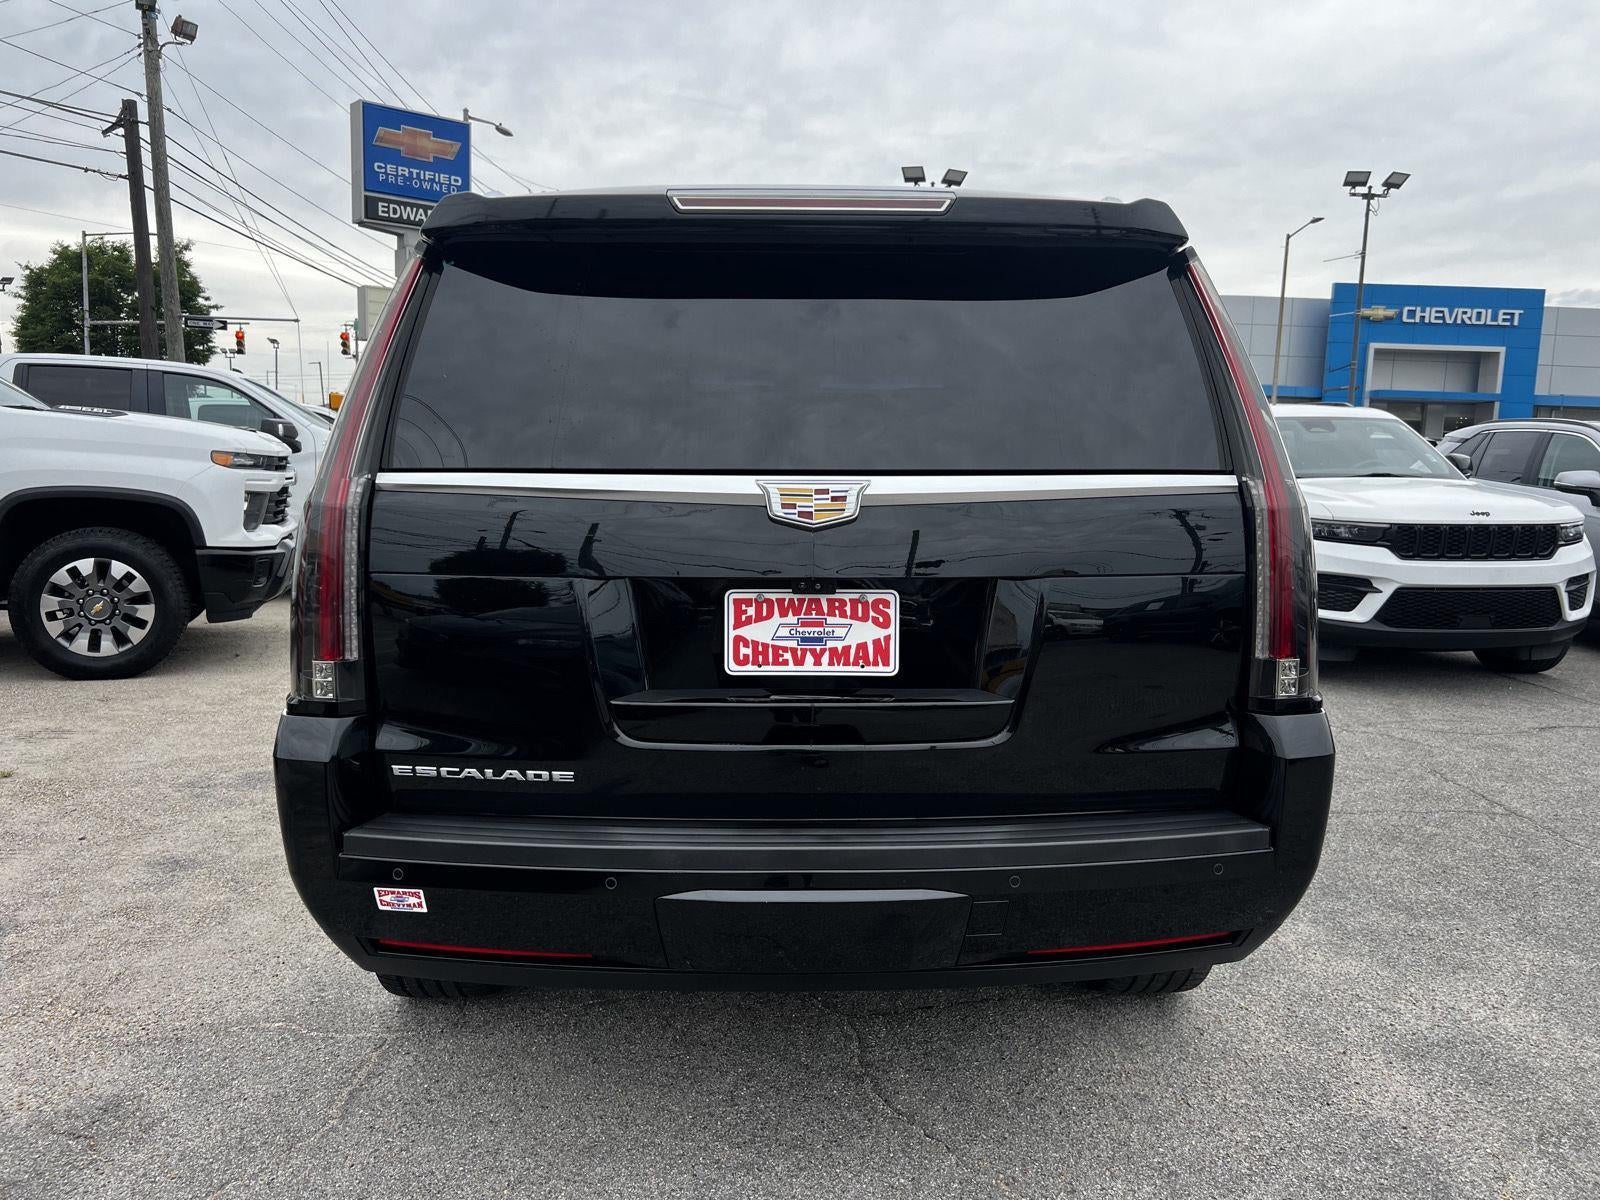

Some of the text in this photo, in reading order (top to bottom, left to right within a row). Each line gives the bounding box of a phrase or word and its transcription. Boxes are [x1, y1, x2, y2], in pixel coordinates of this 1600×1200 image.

[373, 162, 462, 187] CERTIFIED
[379, 173, 458, 194] PRE-OWNED
[1401, 306, 1524, 327] CHEVROLET
[732, 597, 892, 630] EDWARDS
[788, 628, 836, 637] Chevrolet
[732, 634, 892, 667] CHEVYMAN
[391, 764, 575, 782] ESCALADE
[376, 889, 422, 900] EDWARDS
[378, 898, 424, 909] CHEVYMAN
